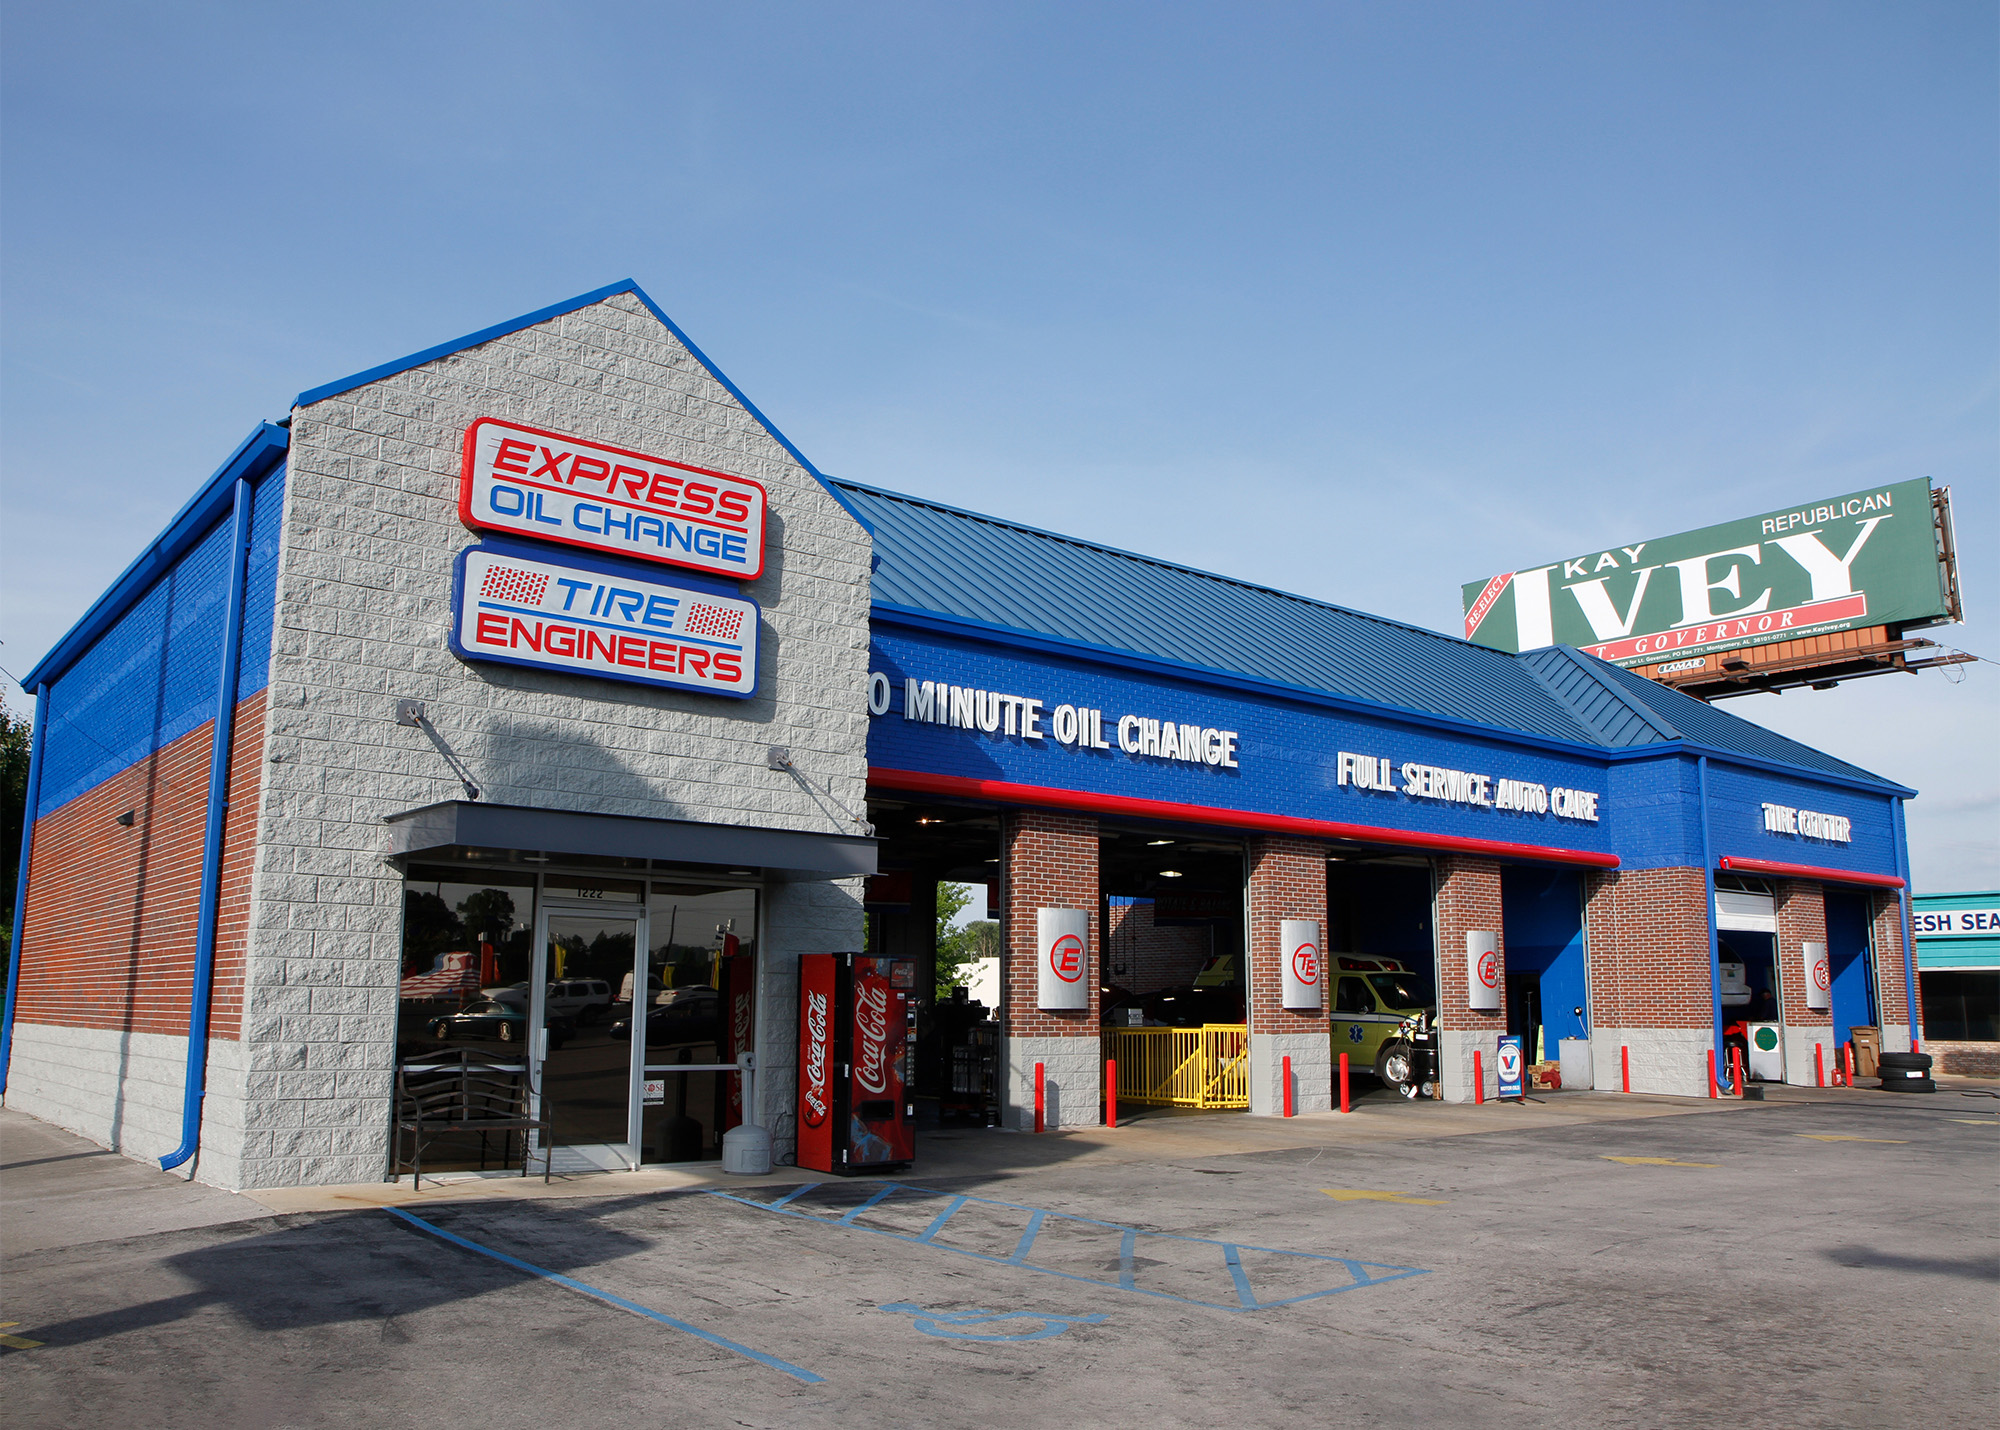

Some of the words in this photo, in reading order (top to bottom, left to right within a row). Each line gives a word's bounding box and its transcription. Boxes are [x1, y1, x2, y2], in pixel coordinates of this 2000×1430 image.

[491, 437, 752, 523] EXPRESS
[490, 485, 561, 526] OIL
[573, 503, 748, 564] CHANGE
[1761, 491, 1892, 535] REPUBLICAN
[1513, 513, 1893, 652] IVEY
[1563, 544, 1646, 579] KAY
[557, 578, 680, 629] TIRE
[1467, 575, 1504, 627] RE-ELECT
[476, 612, 742, 683] ENGINEERS
[1635, 612, 1793, 653] GOVERNOR
[1646, 653, 1671, 663] Governor,
[1662, 658, 1701, 673] LAMAR
[904, 678, 1043, 740] MINUTE
[1053, 704, 1110, 749] OIL
[1118, 714, 1238, 768] CHANGE
[1337, 751, 1397, 792] FULL
[1402, 762, 1490, 806] SERVICE
[1496, 778, 1548, 814] AUTO
[1551, 787, 1599, 821] CARE
[1761, 802, 1798, 834] TIRE
[1798, 810, 1852, 842] CENTER
[577, 888, 603, 898] 1222
[1960, 913, 2000, 930] SEA
[1298, 953, 1318, 976] TE
[807, 989, 827, 1086] Coca-Cola
[855, 980, 888, 1093] Coca-Cola
[805, 1091, 827, 1117] Coca-Cola
